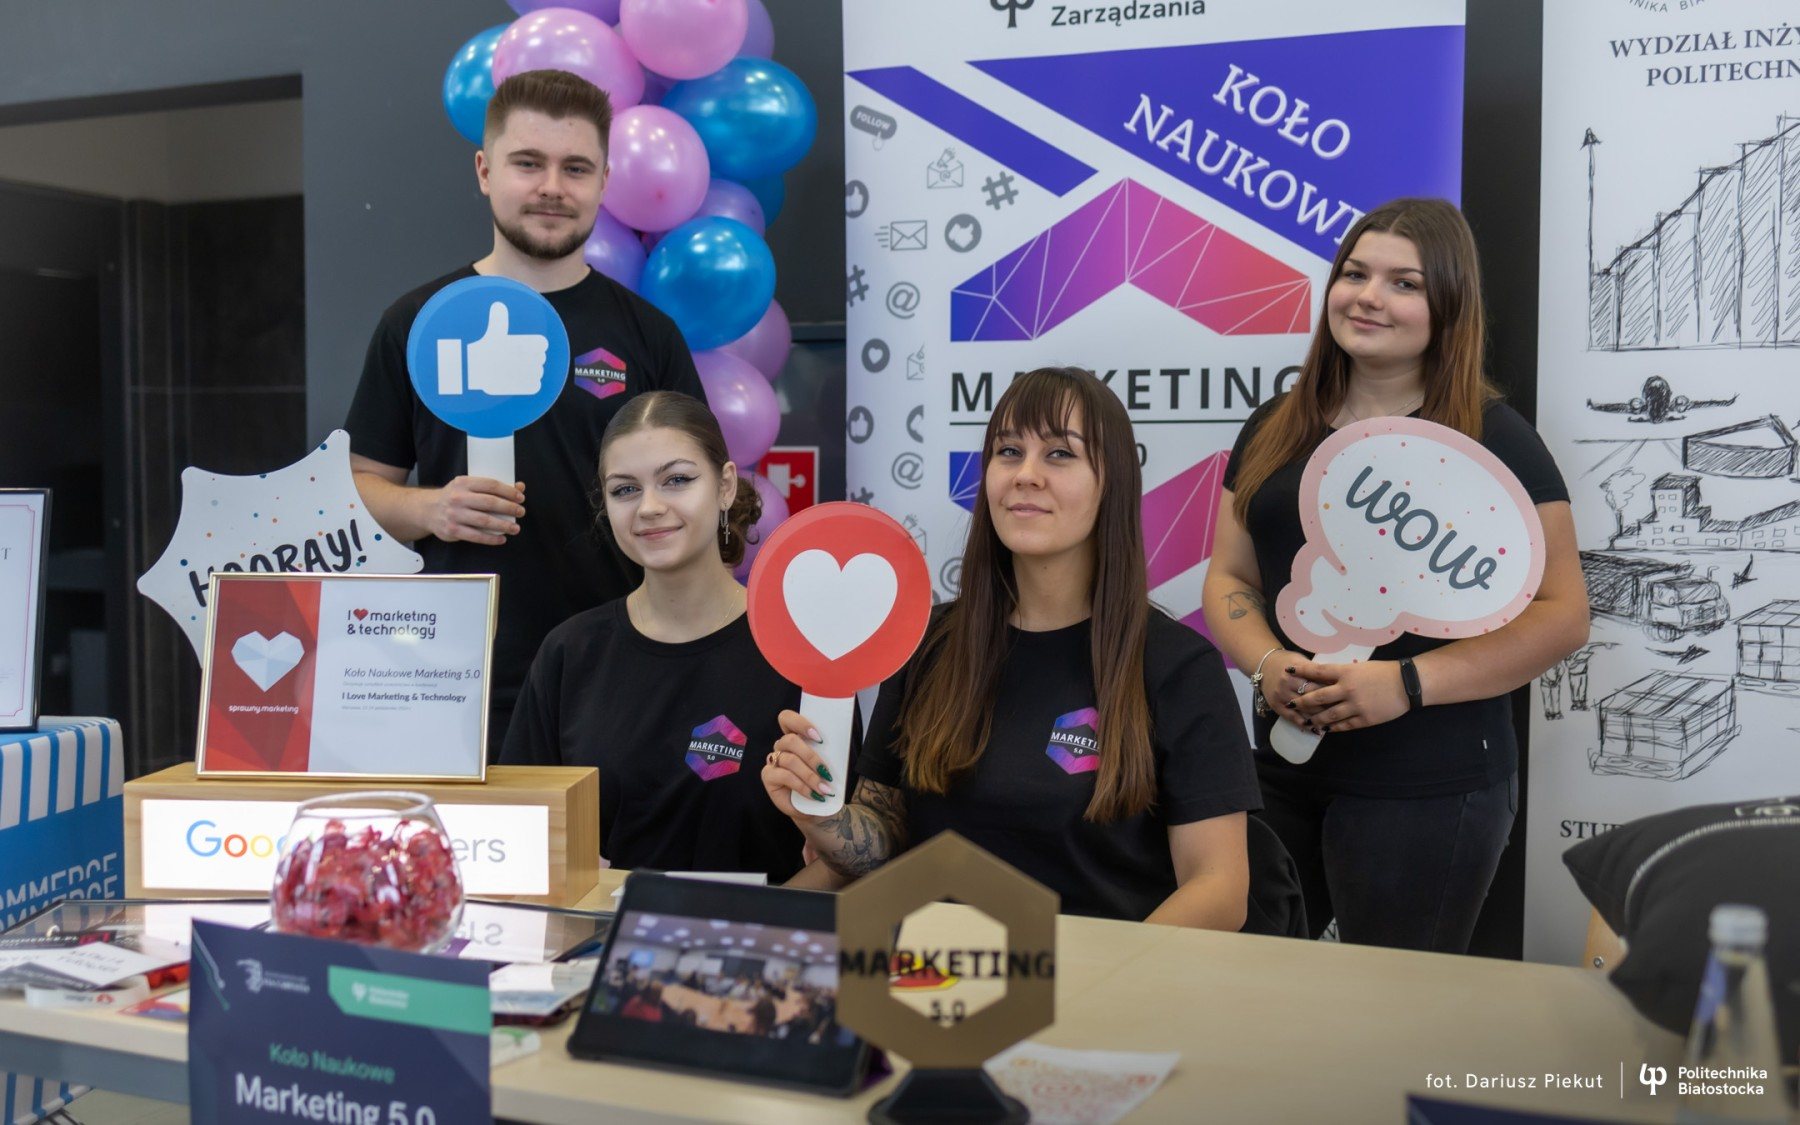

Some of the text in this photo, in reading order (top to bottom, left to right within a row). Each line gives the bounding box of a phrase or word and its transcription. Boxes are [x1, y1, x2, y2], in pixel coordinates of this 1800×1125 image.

[1051, 0, 1206, 27] Zarządzania
[1609, 31, 1737, 58] WYDZIAŁ
[856, 111, 890, 131] FOLLOW
[1212, 63, 1351, 160] KOŁO
[575, 367, 626, 380] MARKETING
[370, 610, 437, 626] marketing
[347, 623, 436, 640] & technology
[368, 668, 412, 679] Naukowe
[414, 669, 463, 681] Marketing
[465, 669, 481, 679] 5.0
[346, 692, 366, 700] Love
[367, 692, 410, 703] Marketing
[420, 693, 467, 703] Technology
[689, 740, 744, 758] MARKETING
[1050, 731, 1100, 750] MARKETI
[1073, 747, 1084, 755] 5.0
[1560, 819, 1625, 839] STU
[840, 949, 1055, 979] MARKETING
[930, 999, 967, 1022] 5.0
[312, 1050, 396, 1085] Naukowe
[235, 1072, 382, 1125] Marketing
